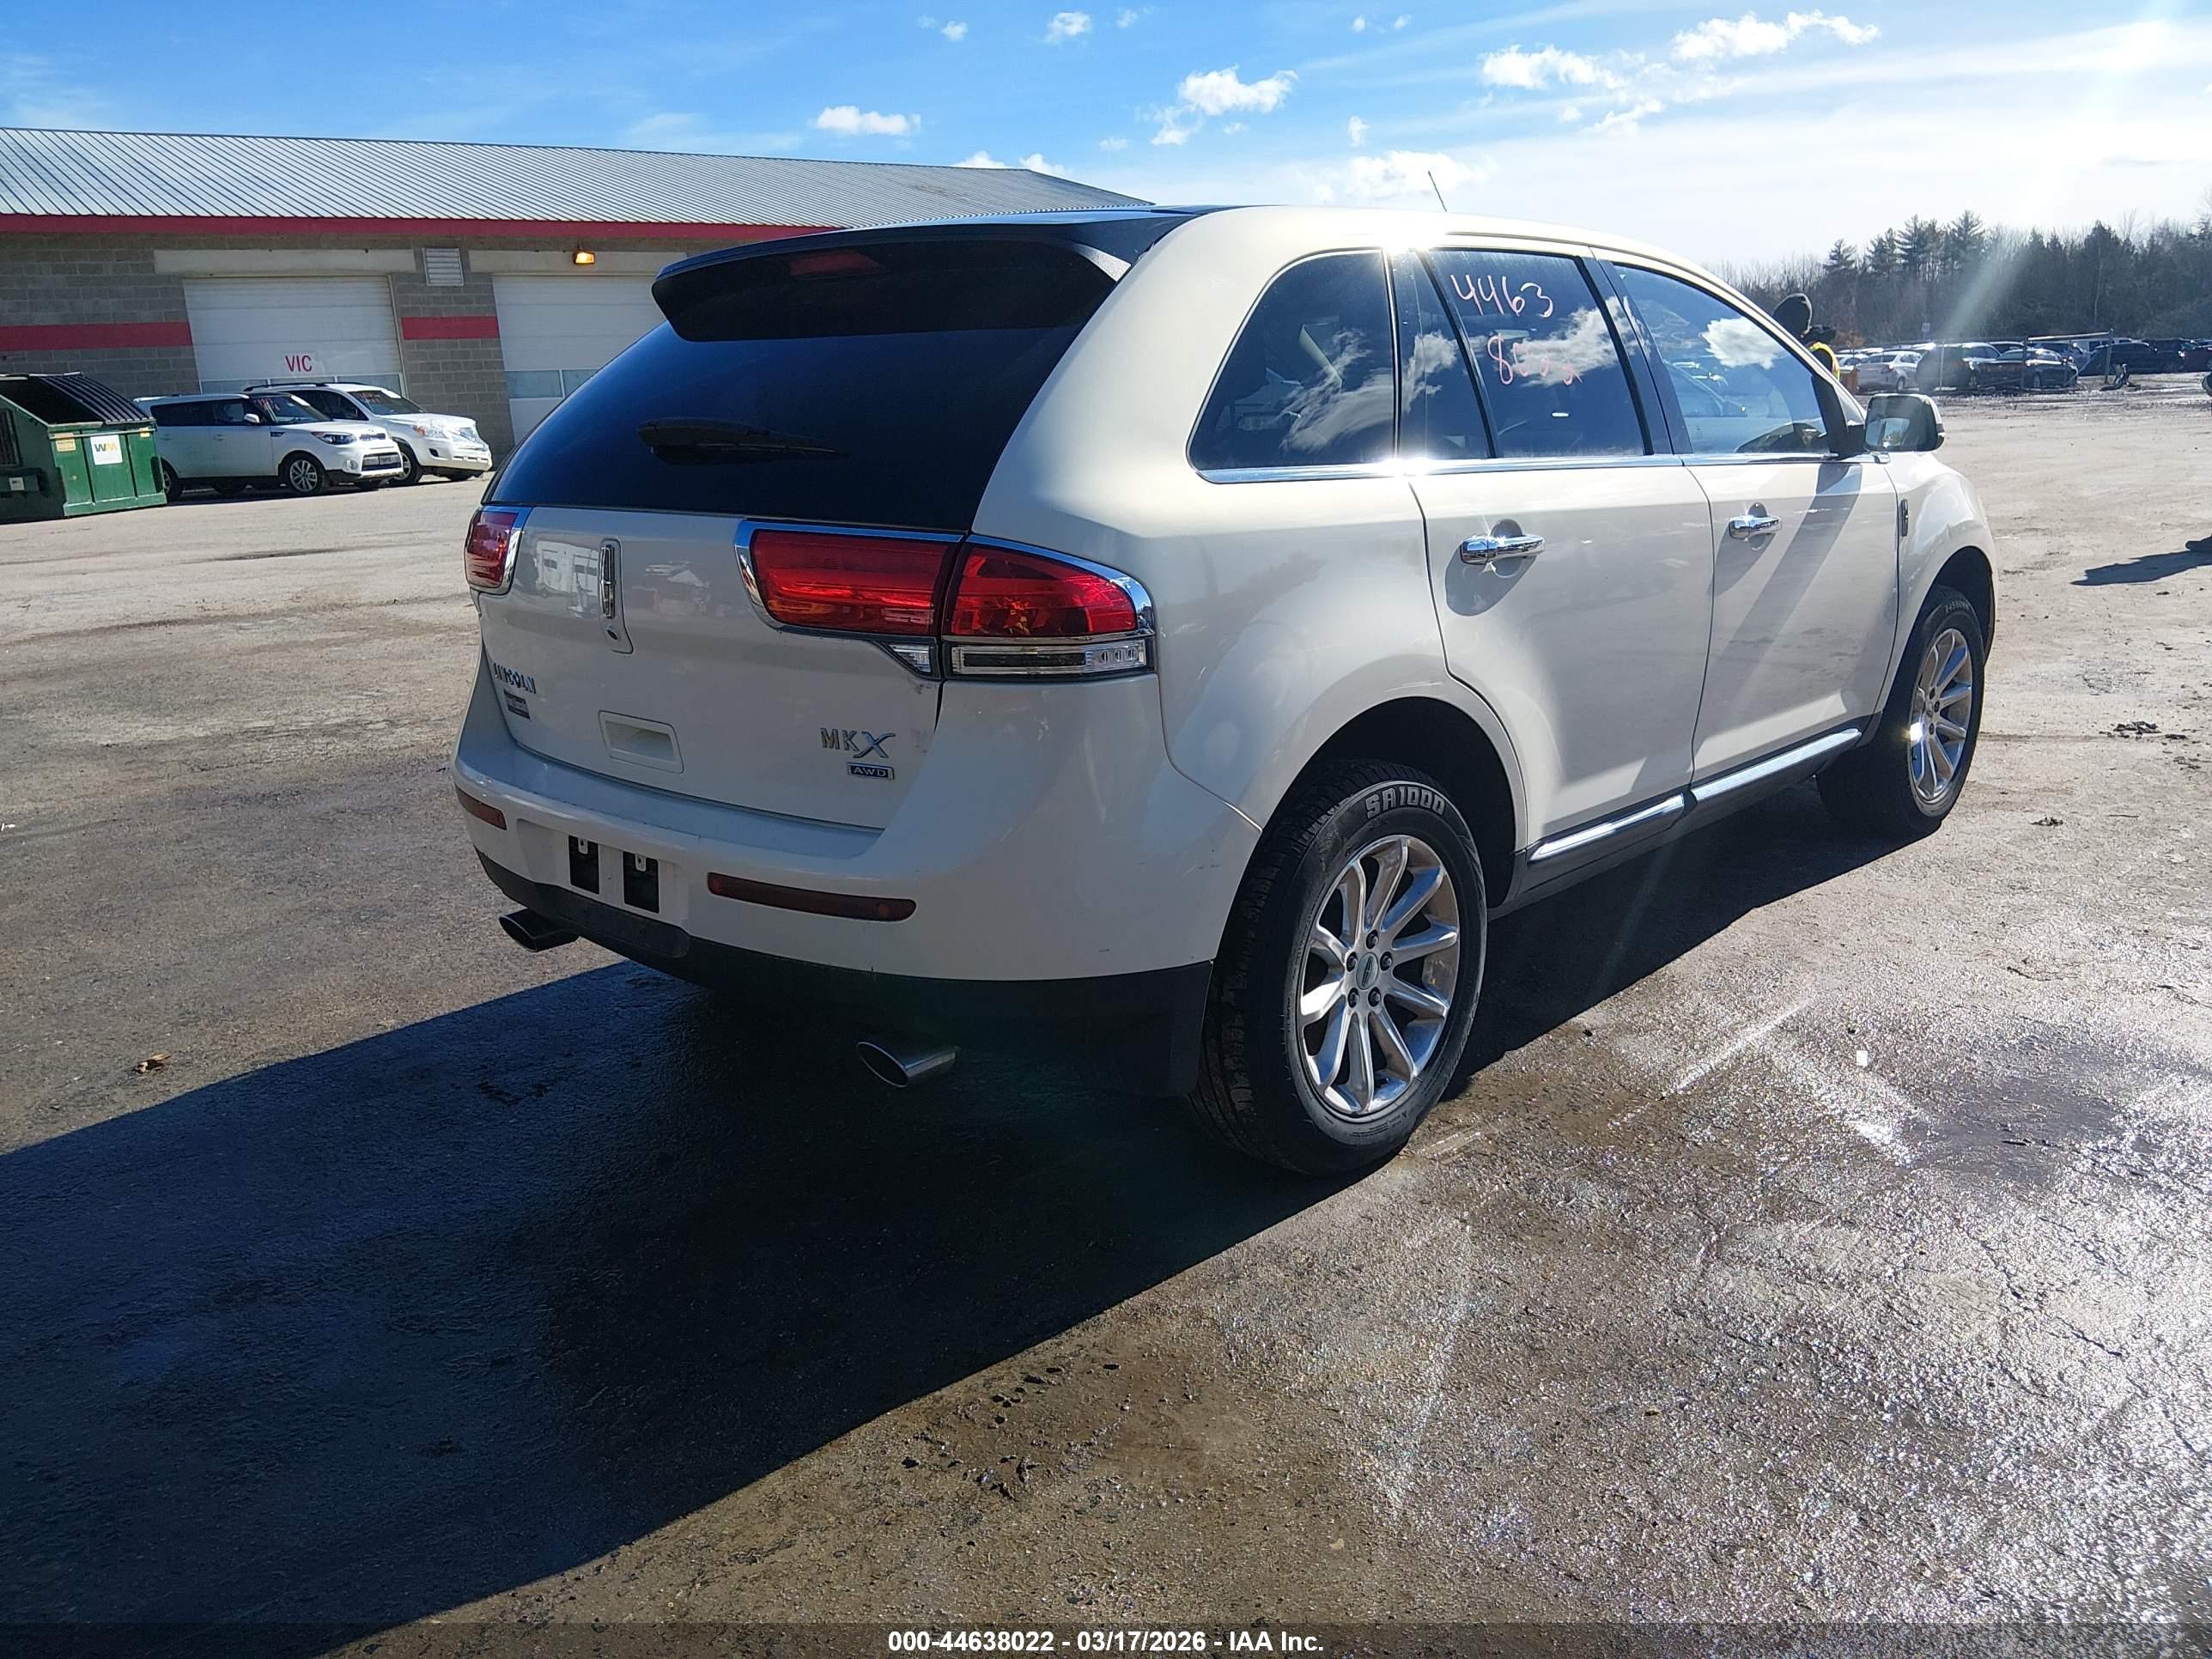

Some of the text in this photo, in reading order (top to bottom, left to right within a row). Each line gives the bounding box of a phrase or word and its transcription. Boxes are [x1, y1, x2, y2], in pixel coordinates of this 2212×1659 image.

[1450, 275, 1553, 318] 4463
[285, 355, 313, 372] VIC
[94, 442, 118, 453] WM
[820, 727, 896, 759] MKX
[853, 766, 887, 777] AWD
[1364, 787, 1446, 819] SA1000
